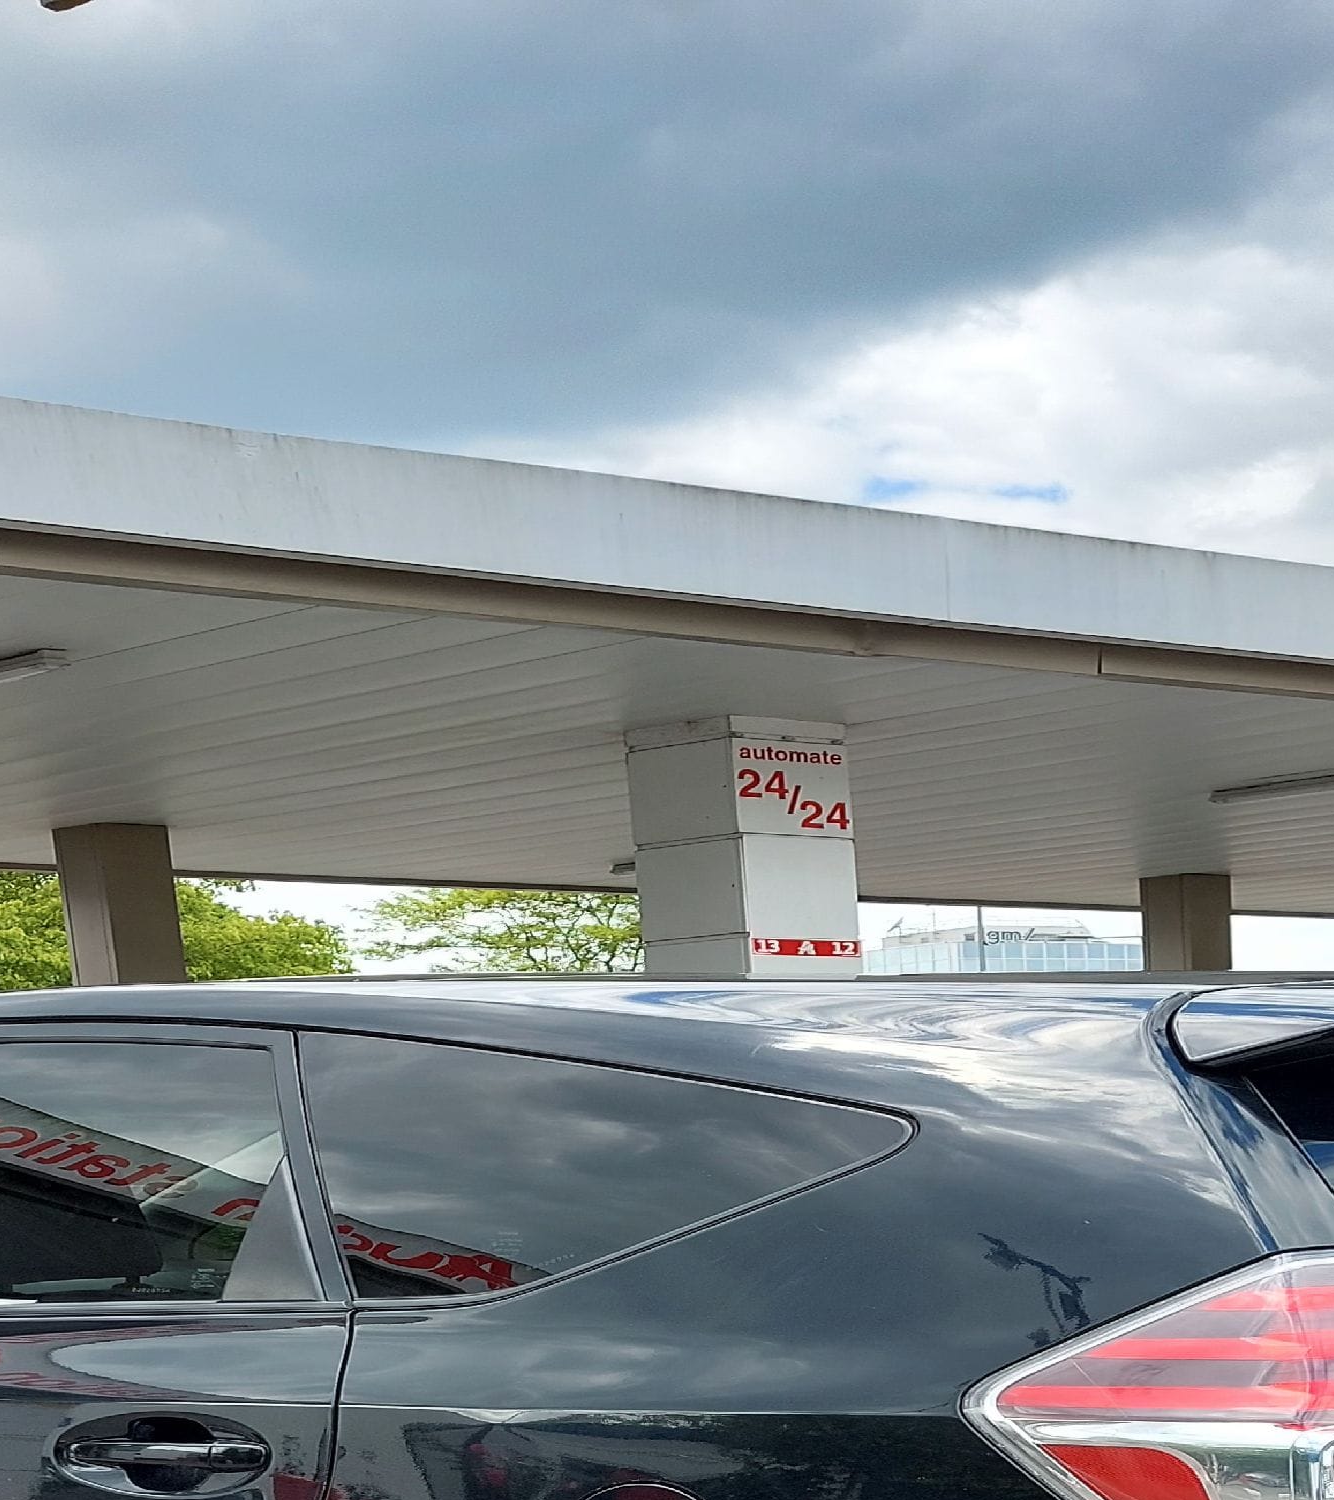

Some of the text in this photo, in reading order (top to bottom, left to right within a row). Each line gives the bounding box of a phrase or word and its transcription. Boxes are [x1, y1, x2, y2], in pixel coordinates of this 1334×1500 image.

[739, 745, 842, 766] automate
[737, 768, 850, 831] 24/24
[755, 938, 781, 954] 13
[831, 941, 856, 955] 12
